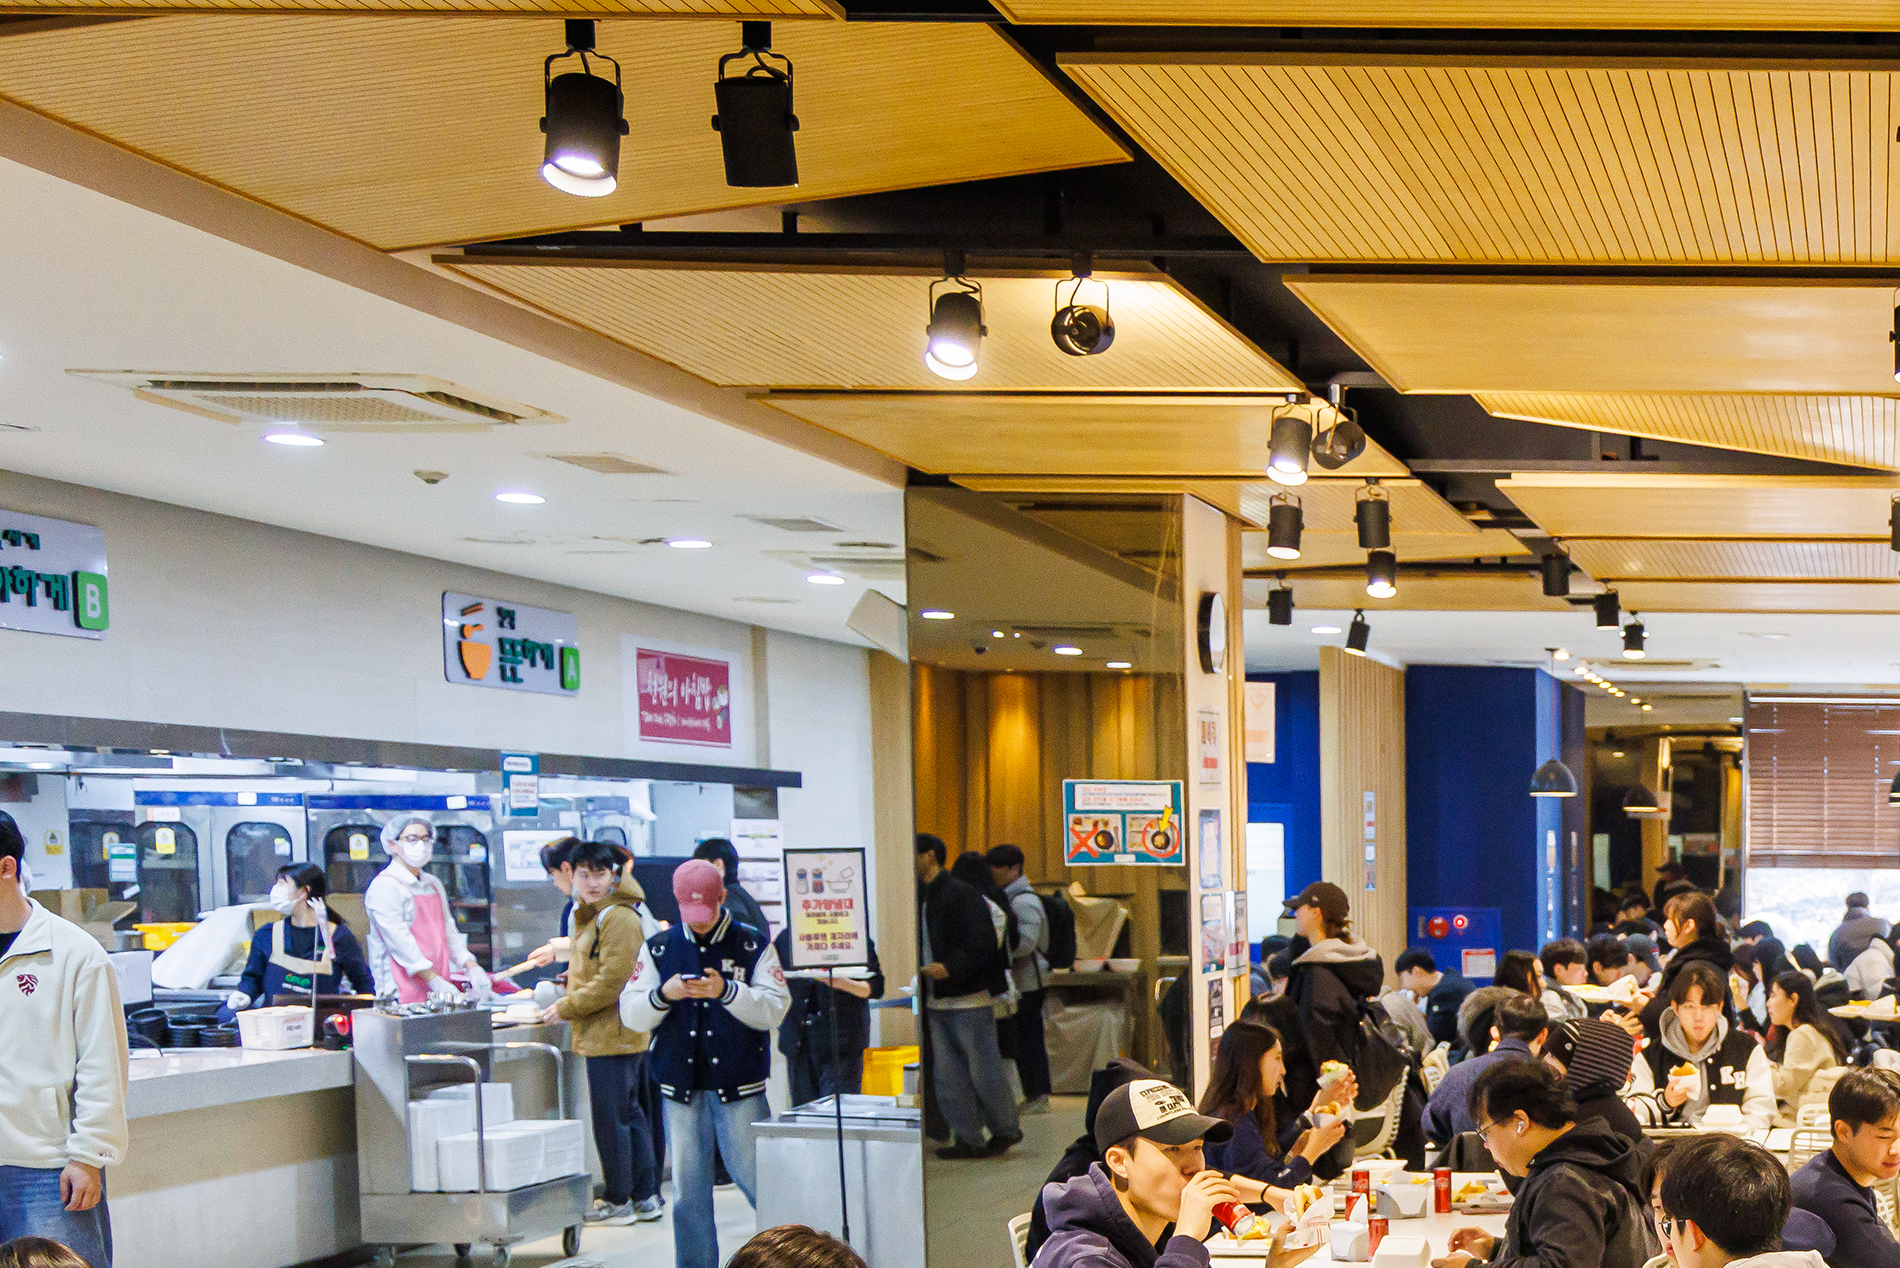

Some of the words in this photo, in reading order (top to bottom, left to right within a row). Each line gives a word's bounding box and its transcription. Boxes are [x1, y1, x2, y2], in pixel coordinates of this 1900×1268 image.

[86, 583, 101, 618] B
[567, 656, 577, 681] A
[681, 671, 713, 713] 아침밥
[1719, 1065, 1746, 1090] KH
